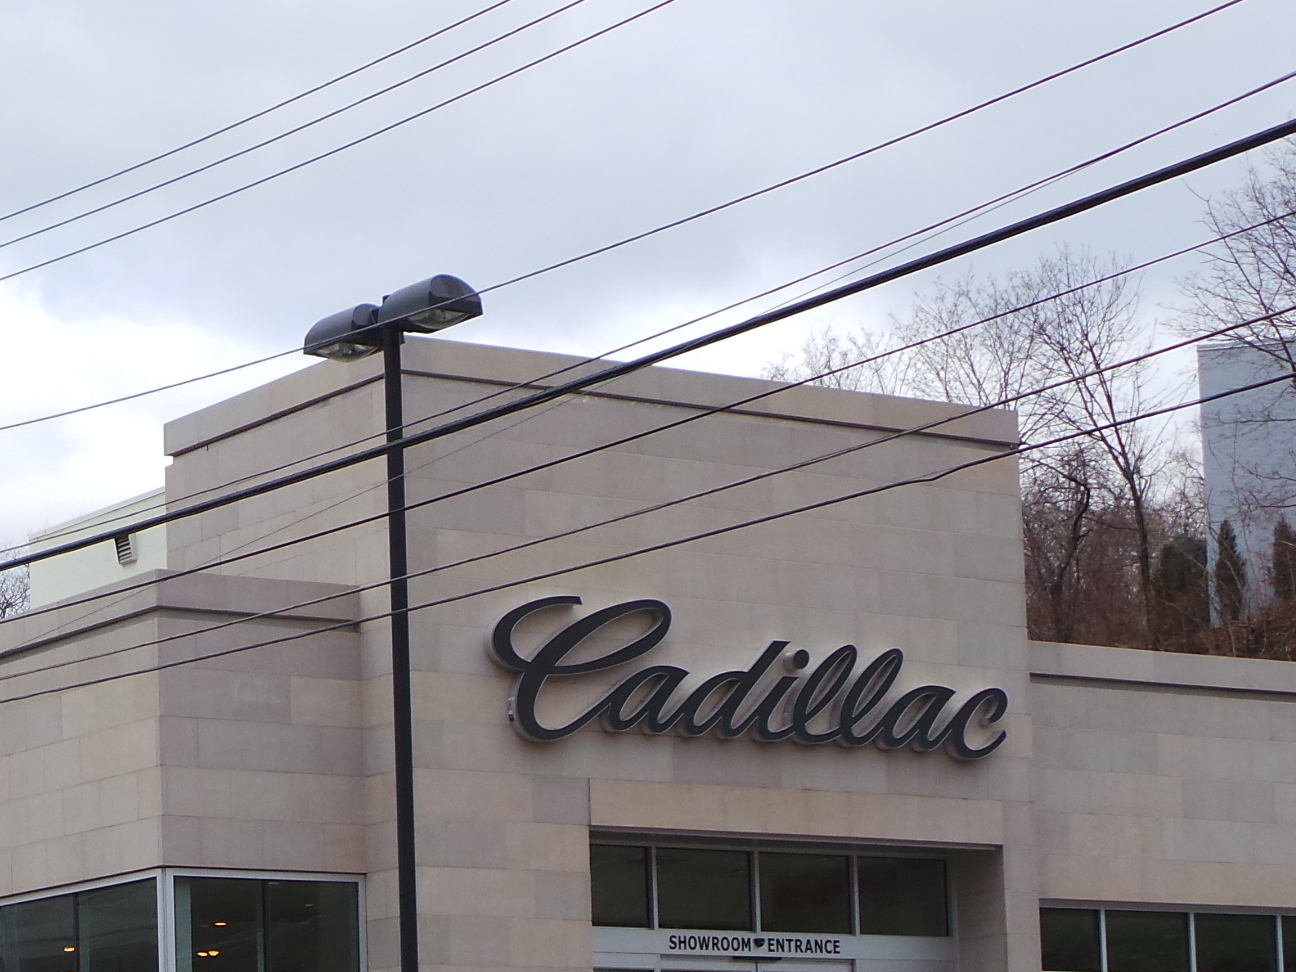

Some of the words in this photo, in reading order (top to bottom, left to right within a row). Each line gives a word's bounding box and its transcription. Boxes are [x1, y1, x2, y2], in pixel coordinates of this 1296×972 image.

[485, 594, 1009, 760] Cadillac
[668, 934, 752, 952] SHOWROOM
[767, 938, 841, 954] ENTRANCE
